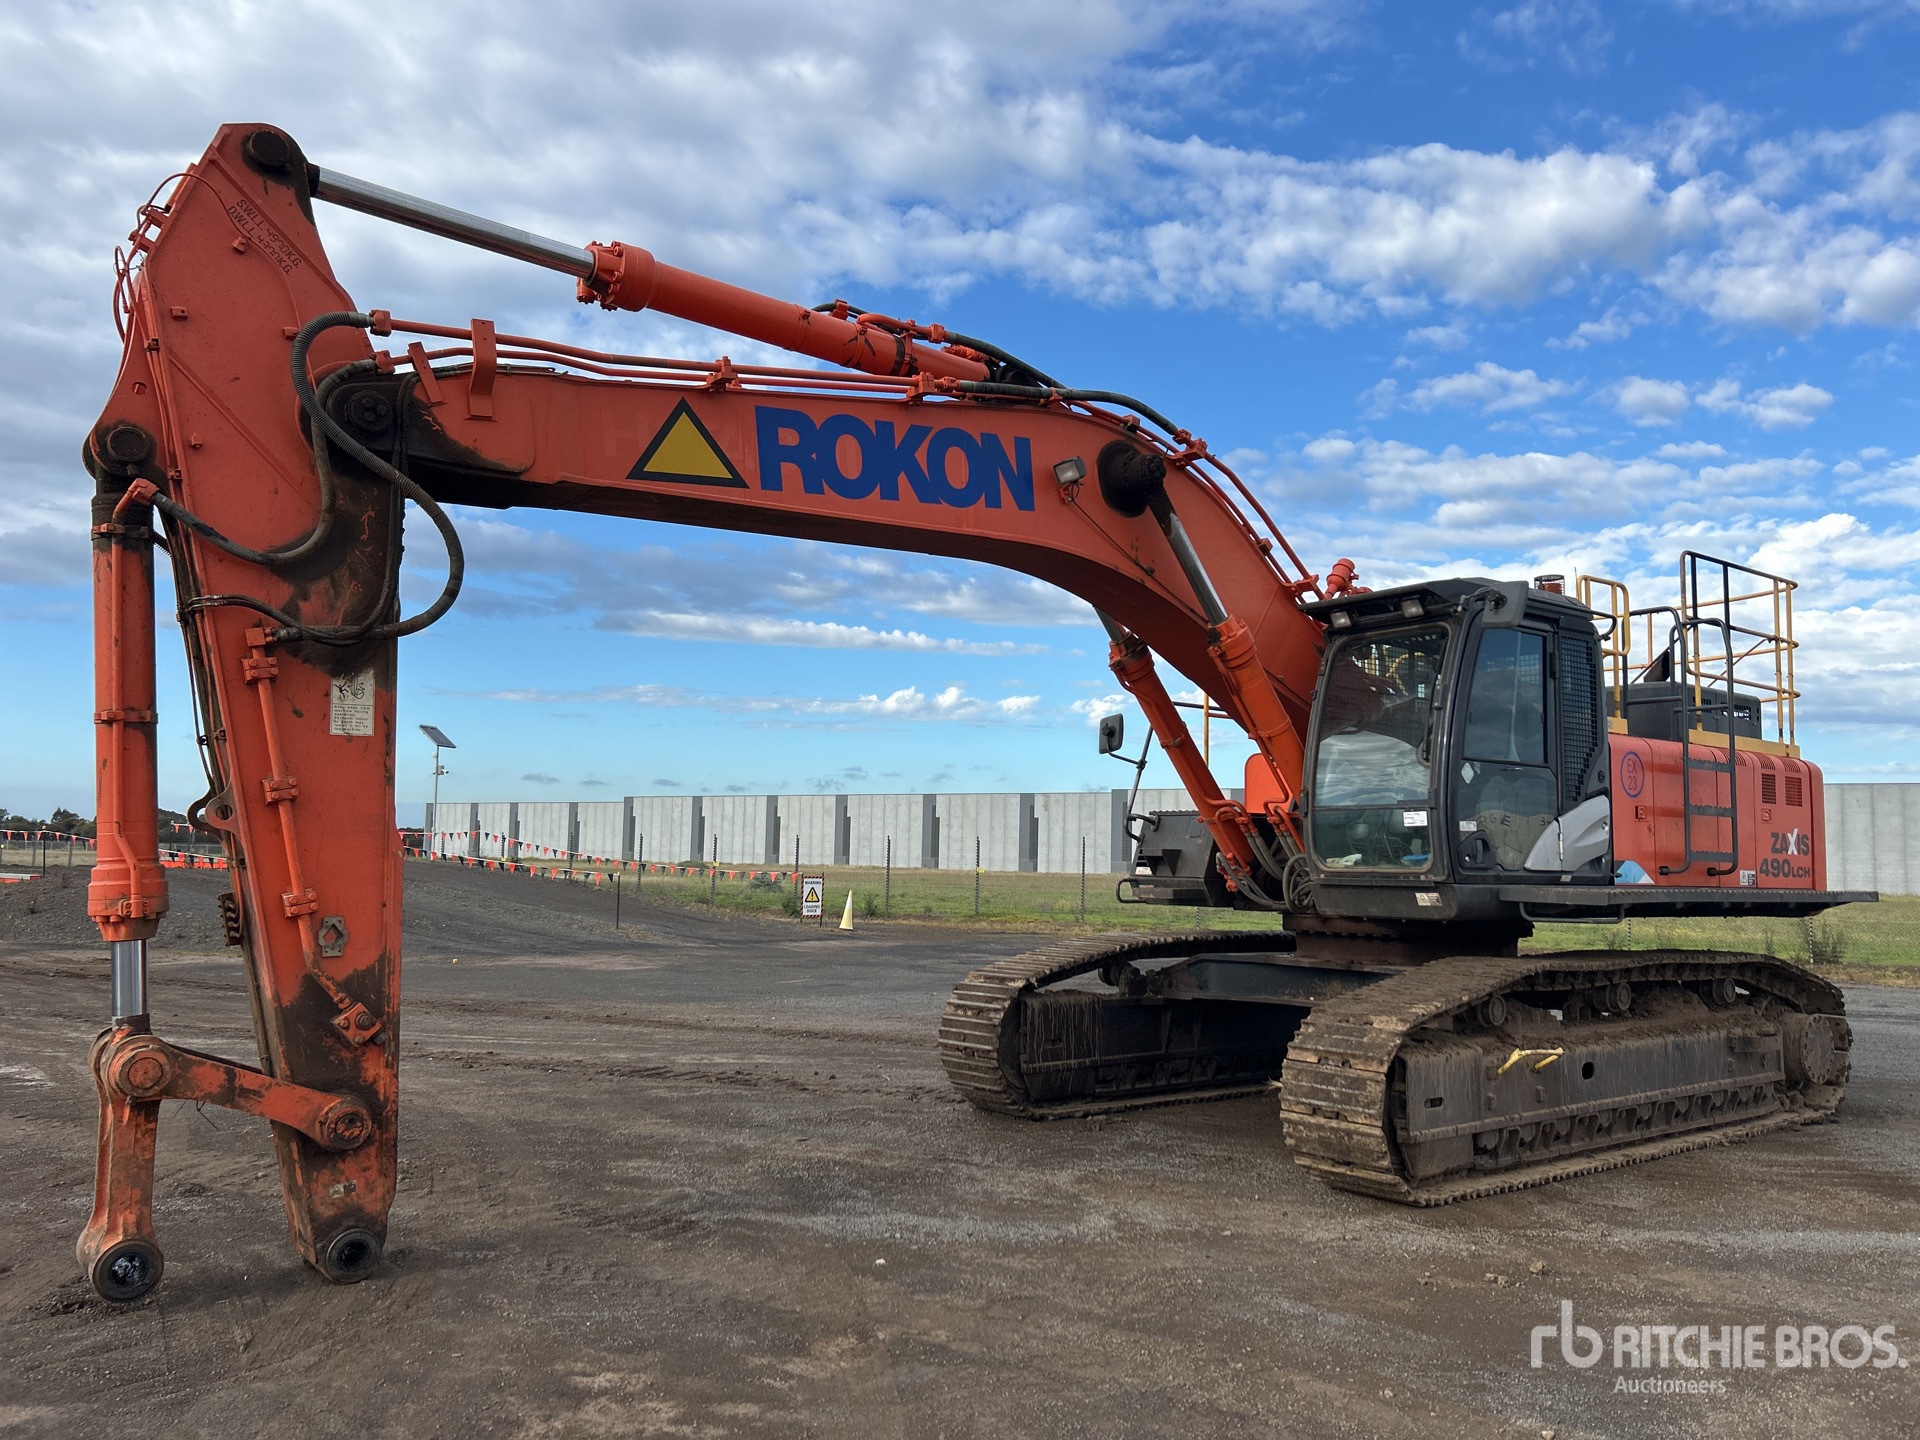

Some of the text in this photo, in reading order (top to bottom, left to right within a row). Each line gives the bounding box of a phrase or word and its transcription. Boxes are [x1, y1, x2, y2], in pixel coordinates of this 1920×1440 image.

[754, 405, 1036, 512] ROKON
[1627, 759, 1637, 773] EX
[1628, 776, 1638, 791] 23
[1771, 827, 1810, 856] ZAXIS
